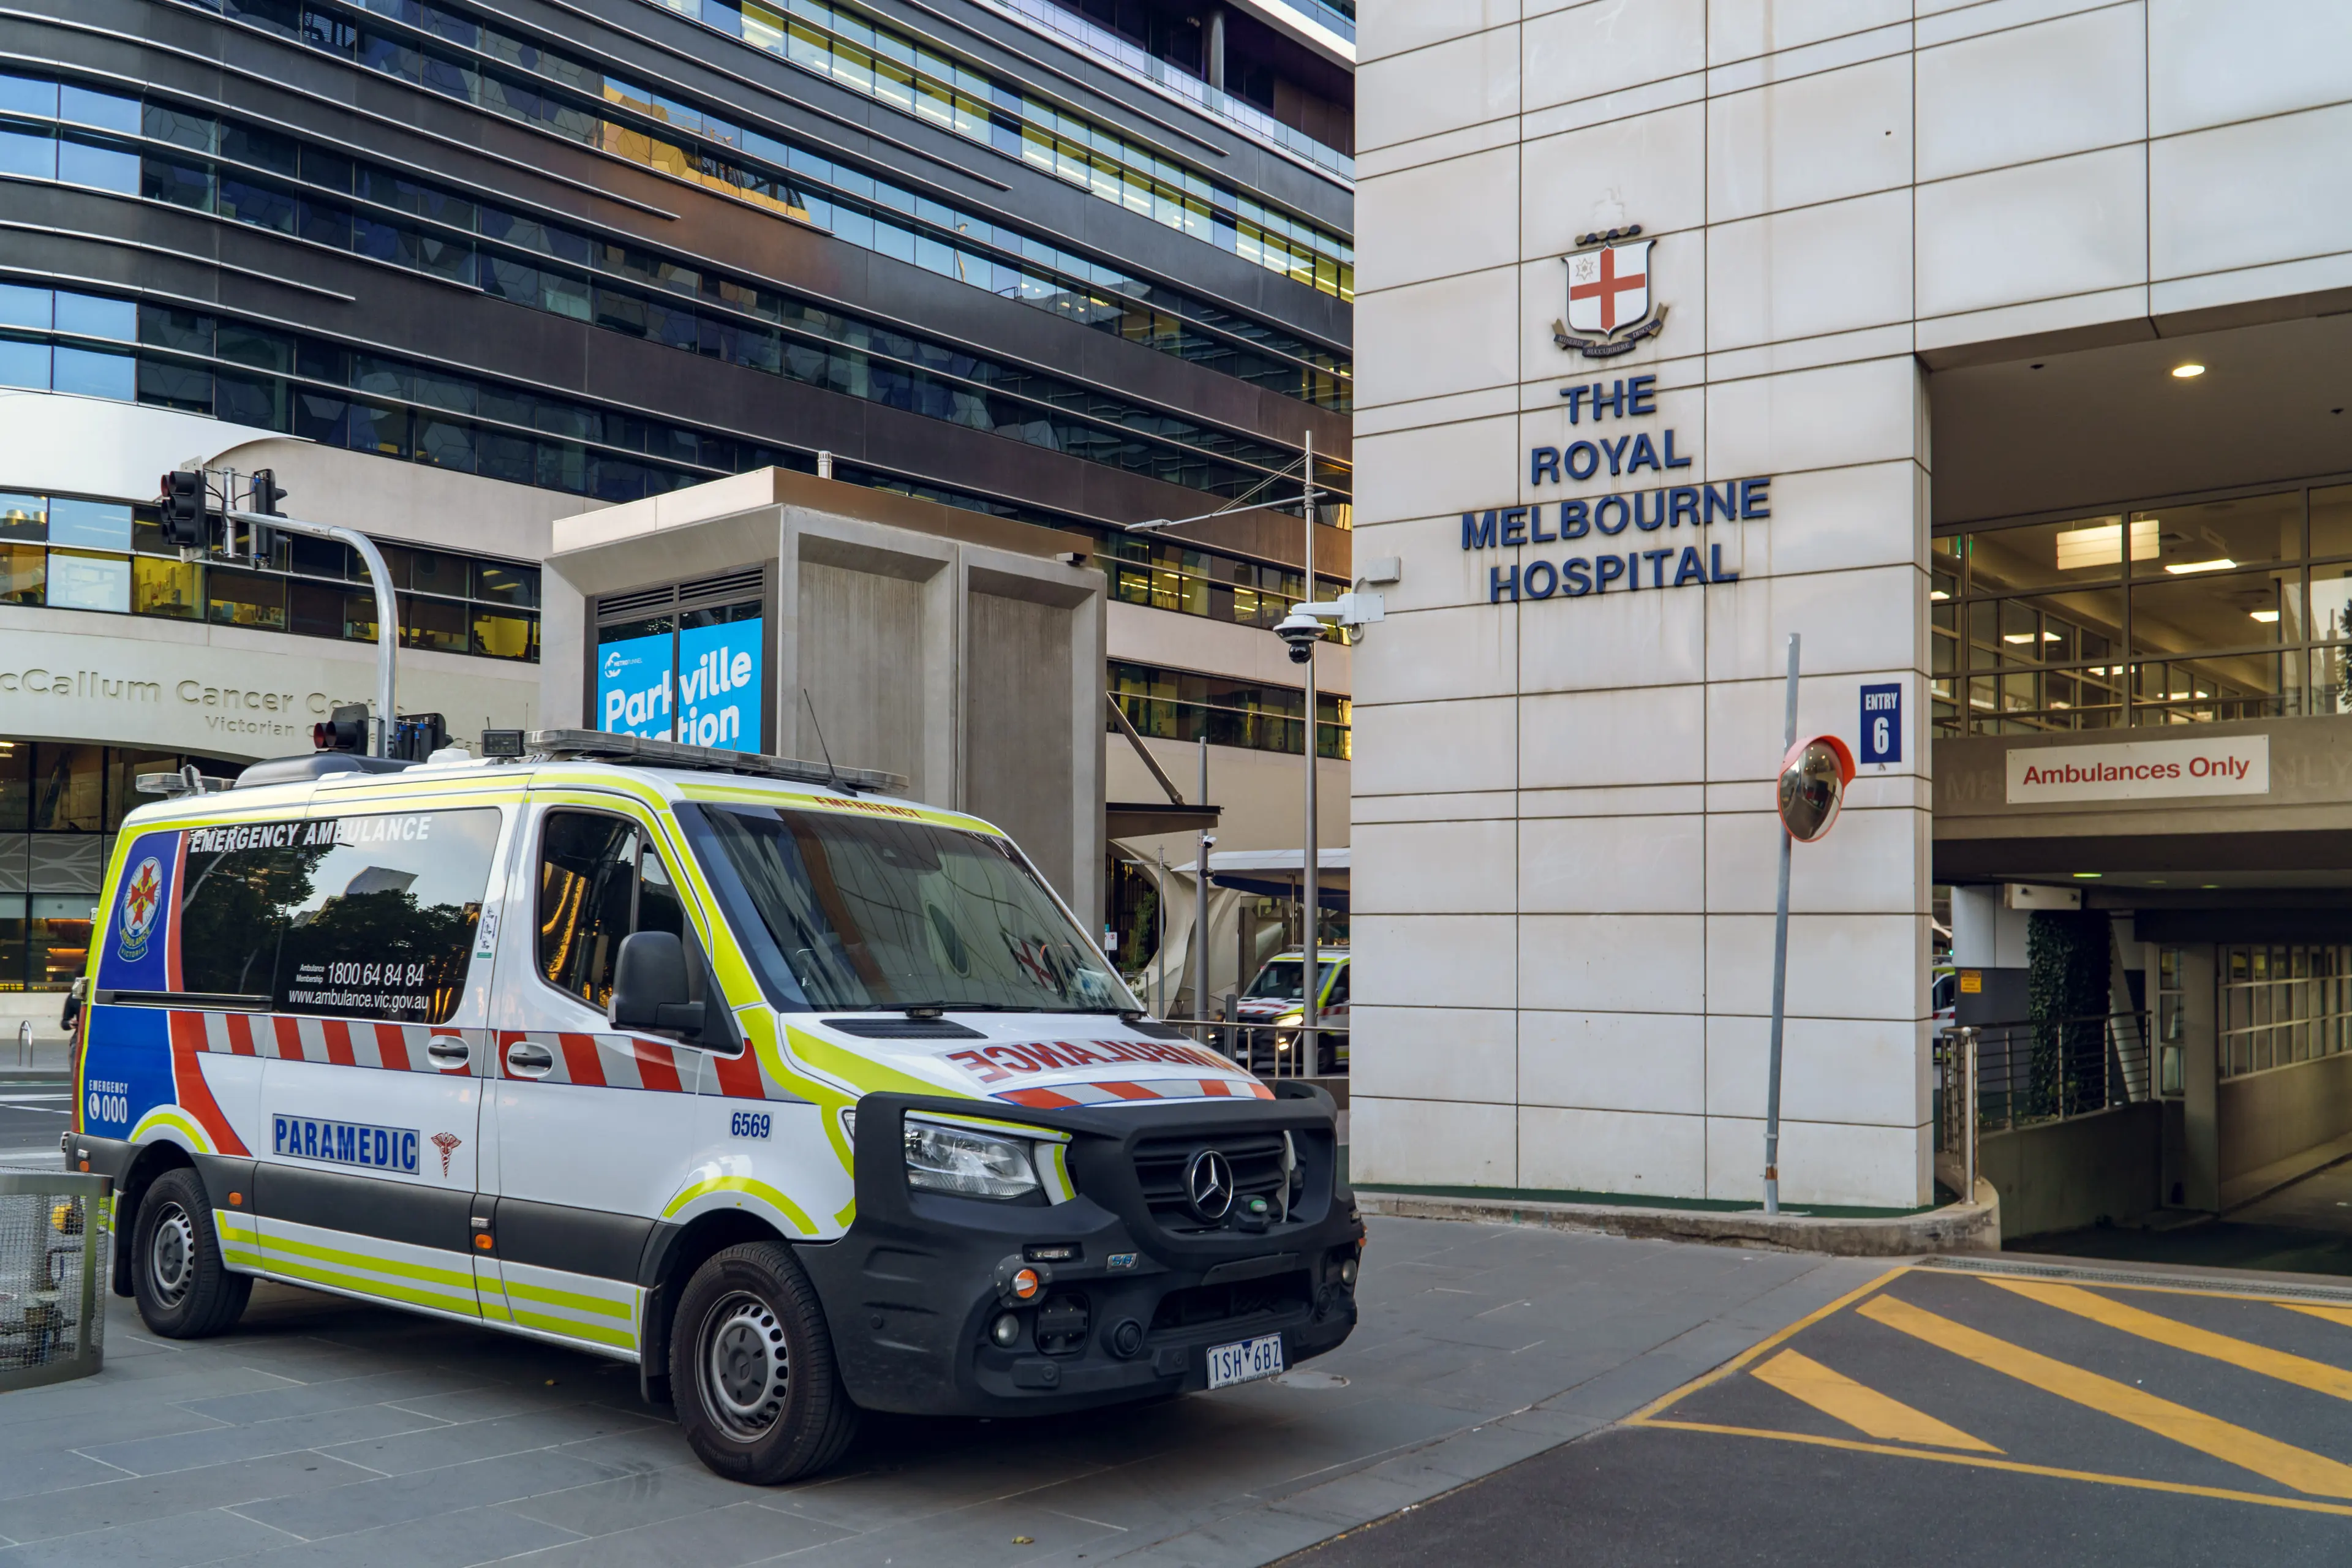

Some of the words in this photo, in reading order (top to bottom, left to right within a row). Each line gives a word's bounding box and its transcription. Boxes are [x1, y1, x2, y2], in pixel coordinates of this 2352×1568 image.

[1558, 335, 1584, 347] MISERIS
[1586, 342, 1630, 355] SUCCURRERE
[1559, 374, 1657, 424] THE
[1531, 429, 1692, 485] ROYAL
[1461, 477, 1772, 550] MELBOURNE
[1490, 543, 1740, 603] HOSPITAL
[176, 680, 294, 713] Cancer
[1865, 692, 1898, 710] ENTRY
[205, 715, 295, 737] Victorian
[1874, 716, 1889, 755] 6
[2022, 763, 2180, 785] Ambulances
[2188, 756, 2250, 780] Only
[813, 796, 922, 819] EMERGENCY
[190, 823, 301, 853] EMERGENCY
[303, 816, 432, 845] AMBULANCE
[121, 926, 150, 947] AMBULANCE
[121, 946, 145, 957] VICTORIA
[296, 974, 323, 984] Membership
[300, 963, 325, 973] Ambulance
[328, 962, 361, 985] 1800
[363, 963, 382, 986] 64
[384, 963, 402, 986] 84
[405, 963, 424, 986] 84
[289, 988, 429, 1012] www.ambulance.vic.gov.au
[89, 1079, 128, 1095] EMERGENCY
[102, 1095, 127, 1124] 000
[731, 1112, 771, 1138] 6569
[276, 1118, 416, 1170] PARAMEDIC
[1213, 1349, 1242, 1381] 1SH
[1254, 1340, 1281, 1371] 6BZ
[1214, 1379, 1234, 1389] VICTORIA
[1246, 1372, 1268, 1382] EDUCATION
